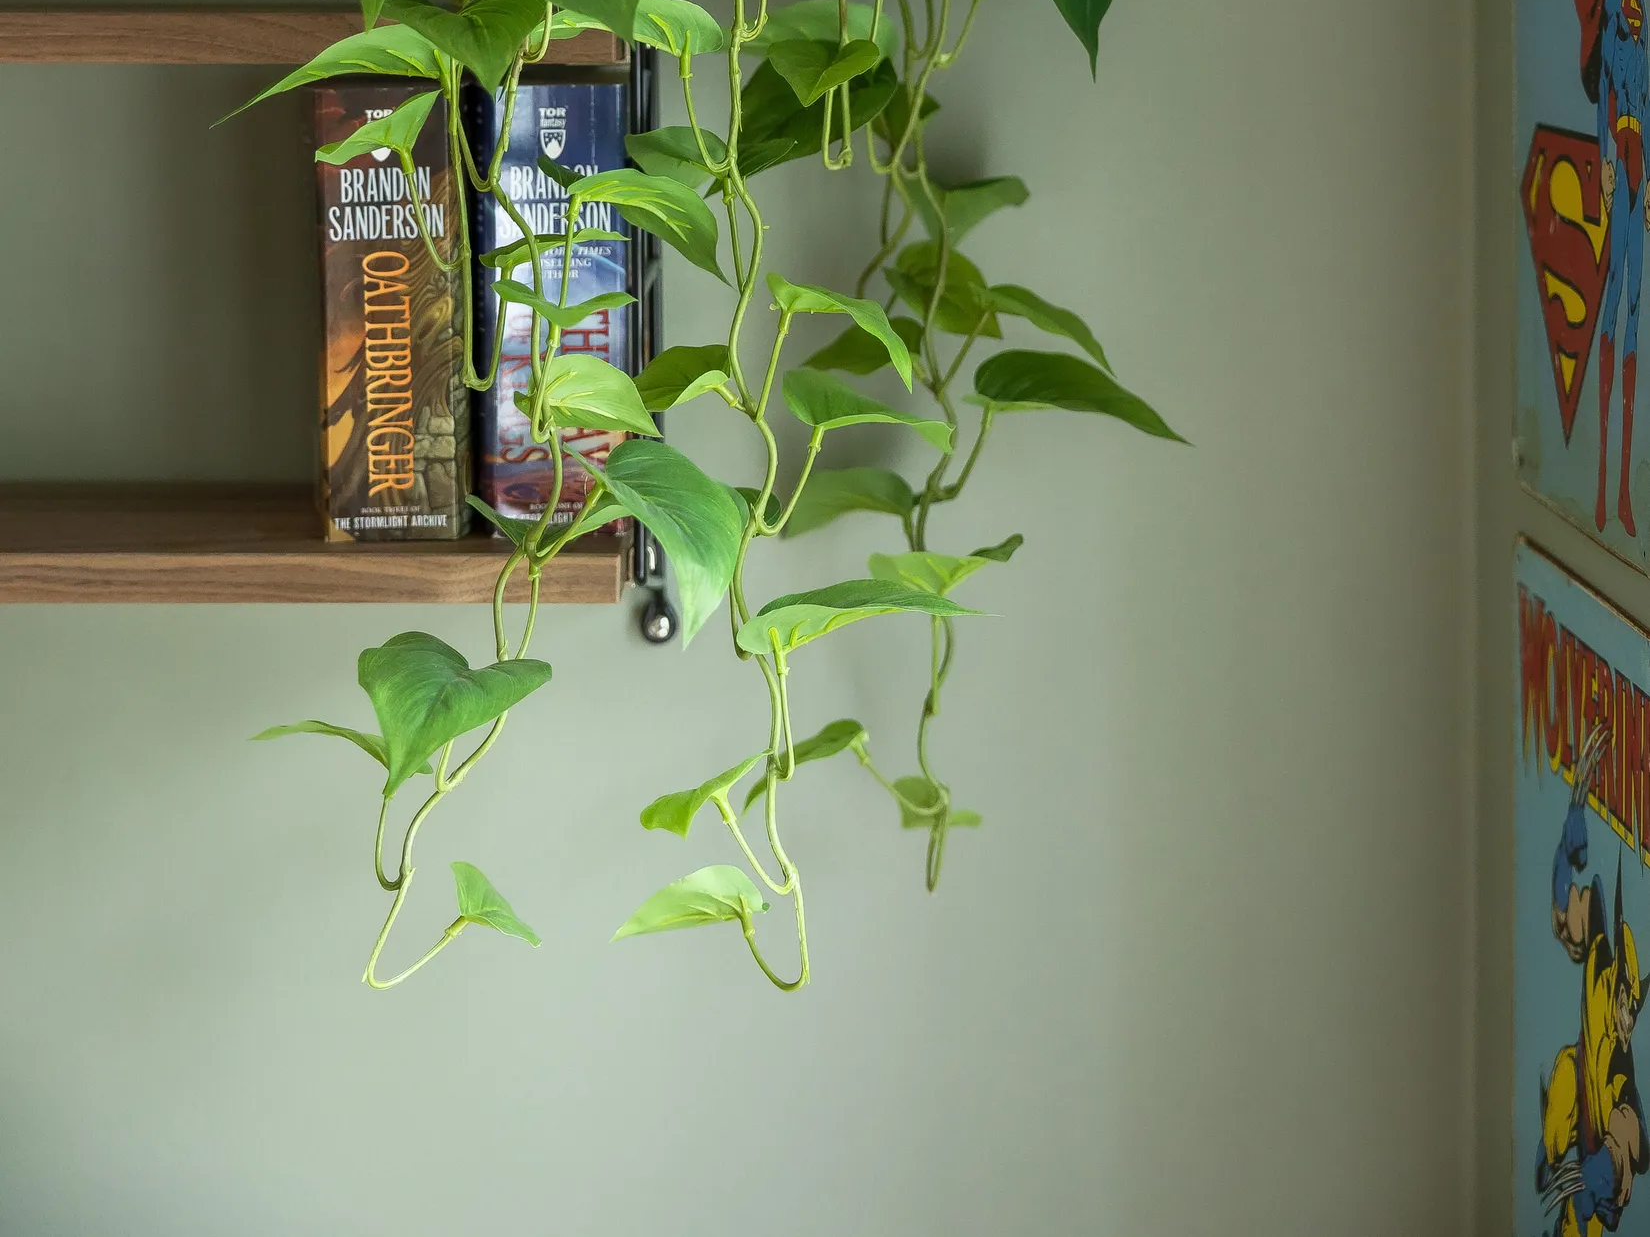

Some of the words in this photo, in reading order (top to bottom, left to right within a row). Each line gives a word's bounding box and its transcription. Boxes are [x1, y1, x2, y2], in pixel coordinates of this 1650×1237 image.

[538, 107, 567, 118] TOR
[328, 203, 444, 242] SANDERSON
[578, 246, 612, 256] TIMES
[361, 250, 415, 496] OATHBRINGER
[333, 517, 351, 530] THE
[353, 515, 408, 529] STORMLIGHT
[411, 514, 447, 527] ARCHIVE
